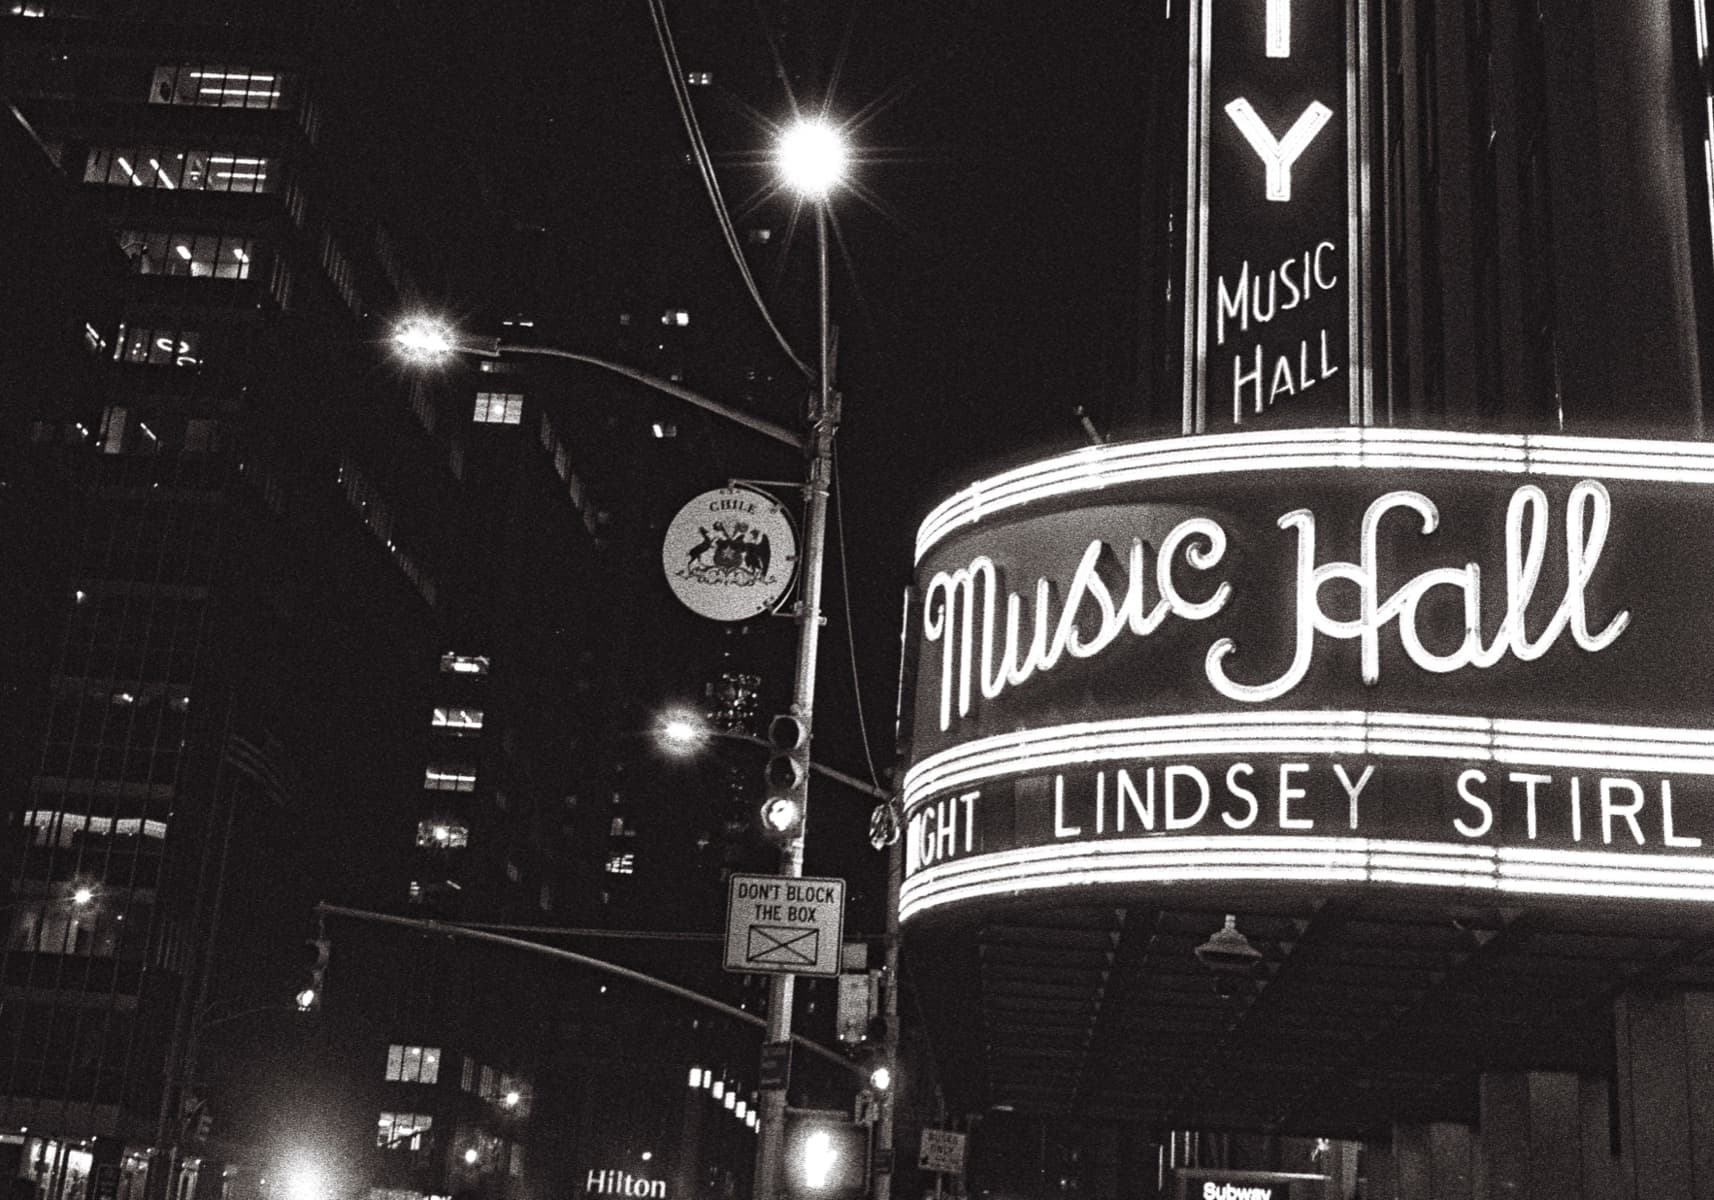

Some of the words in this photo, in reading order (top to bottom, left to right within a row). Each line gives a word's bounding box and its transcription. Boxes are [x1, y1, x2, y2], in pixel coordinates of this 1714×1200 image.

[1217, 241, 1337, 344] MUSIC
[1233, 329, 1338, 424] HALL
[709, 499, 758, 515] CHILE
[924, 517, 1231, 731] Music
[1206, 479, 1631, 702] Hall
[1054, 763, 1375, 838] LINDSEY
[1453, 769, 1703, 848] STIRL
[738, 883, 781, 900] DON'T
[786, 885, 835, 903] BLOCK
[755, 904, 782, 921] THE
[787, 906, 817, 923] BOX
[586, 1169, 667, 1199] Hilton
[1203, 1182, 1272, 1200] Subway
